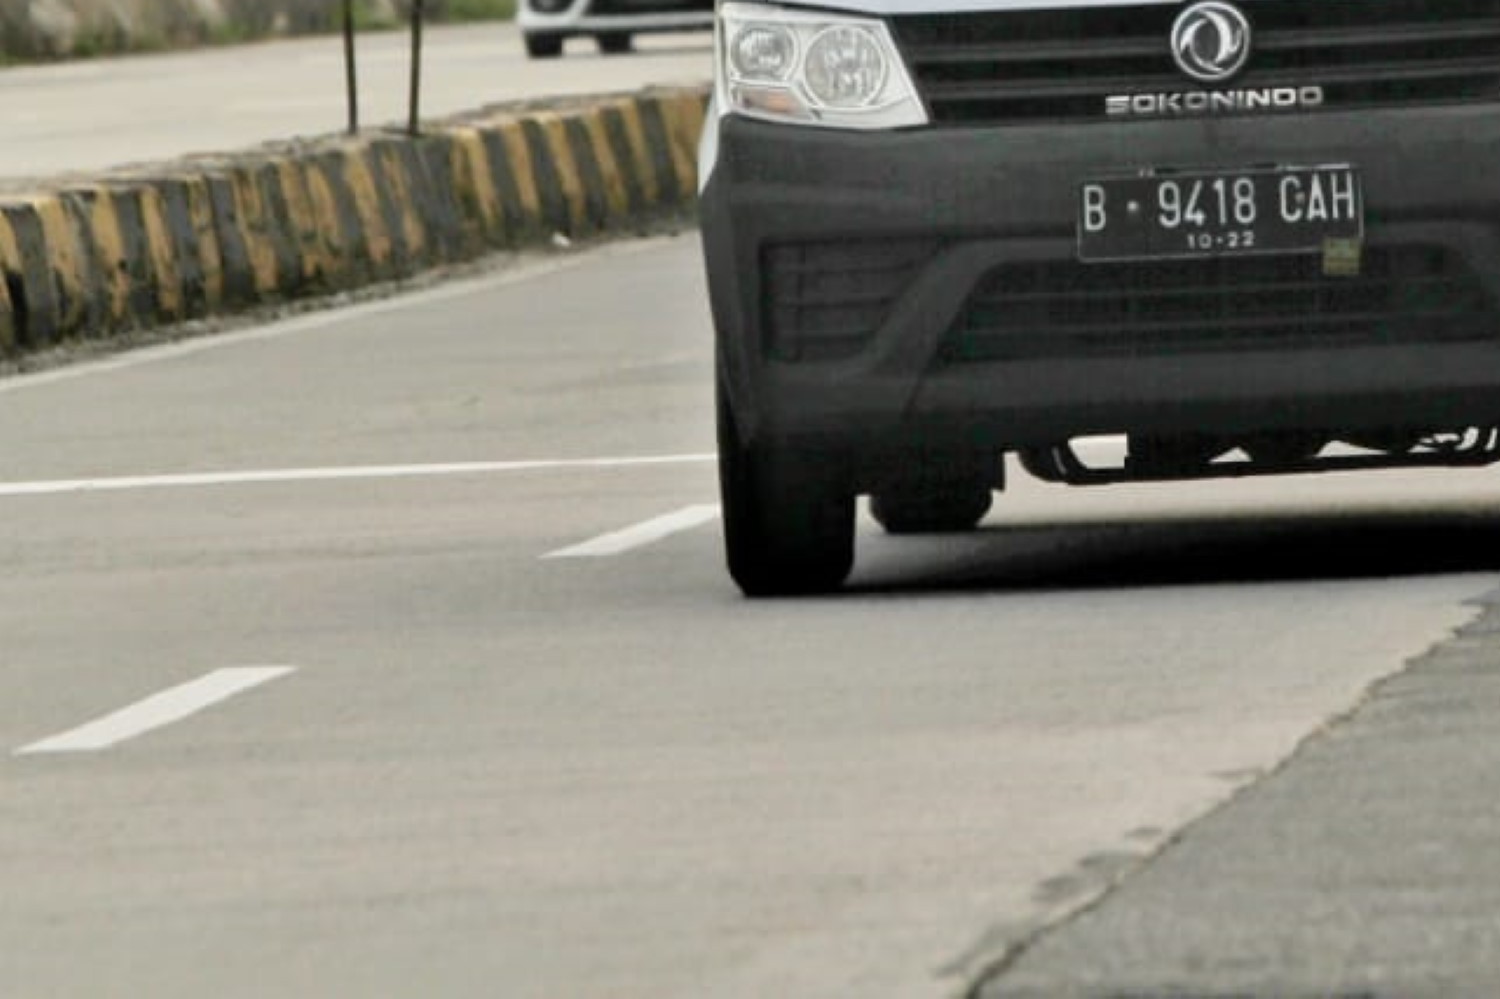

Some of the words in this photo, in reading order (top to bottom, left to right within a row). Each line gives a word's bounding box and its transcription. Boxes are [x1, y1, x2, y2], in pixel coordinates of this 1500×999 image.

[1104, 85, 1324, 115] SOKONINDO
[1083, 184, 1107, 231] B
[1157, 176, 1257, 229] 9418
[1278, 171, 1356, 223] CAH
